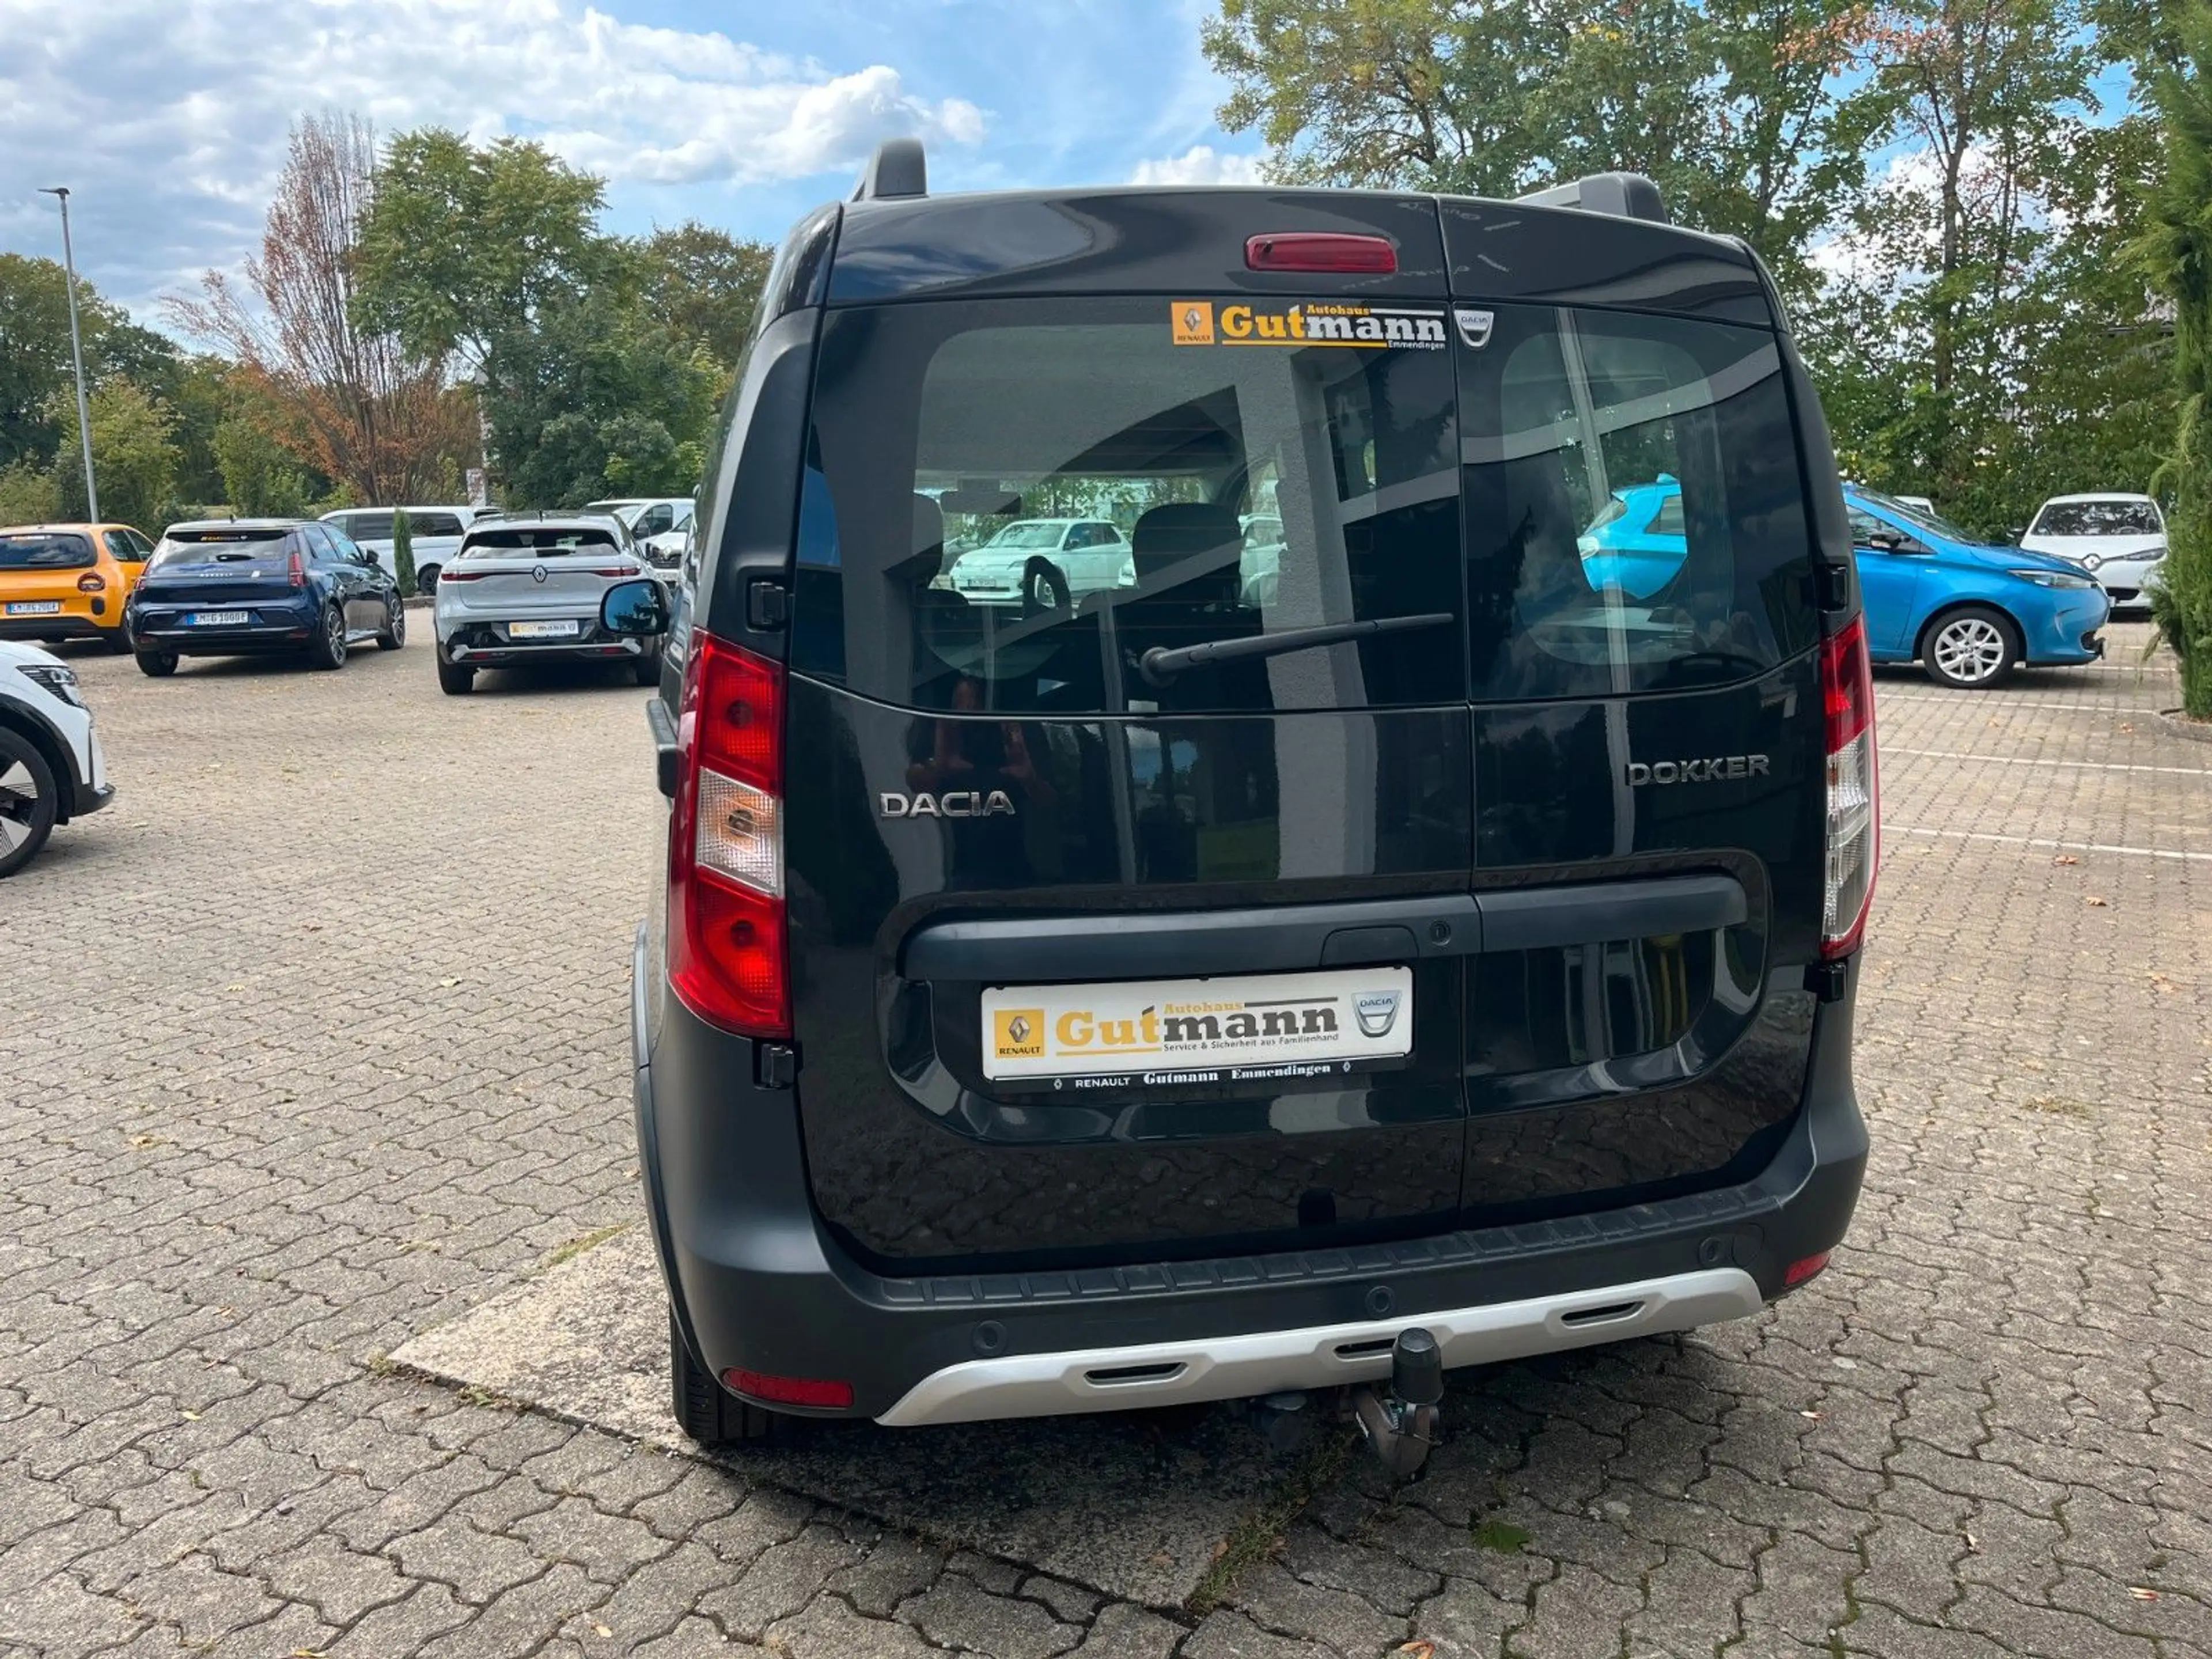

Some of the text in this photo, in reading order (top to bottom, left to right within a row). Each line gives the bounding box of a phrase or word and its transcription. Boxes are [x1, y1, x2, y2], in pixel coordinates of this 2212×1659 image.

[1306, 304, 1370, 316] Autohaus
[1221, 305, 1446, 341] Gutmann
[1388, 340, 1445, 350] Emmendingen
[1626, 754, 1770, 786] DOKKER
[880, 790, 1016, 817] DACIA
[1164, 1001, 1244, 1014] Autohaus
[1359, 997, 1393, 1007] DACIA
[1056, 1005, 1338, 1046] Gutmann
[999, 1046, 1041, 1055] RENAULT
[1164, 1043, 1197, 1052] Service
[1201, 1041, 1207, 1050] &
[1211, 1038, 1257, 1050] Sicherheit
[1279, 1033, 1339, 1045] Familienhand
[1075, 1065, 1331, 1088] RENAULT Gutmann Emmendingen
